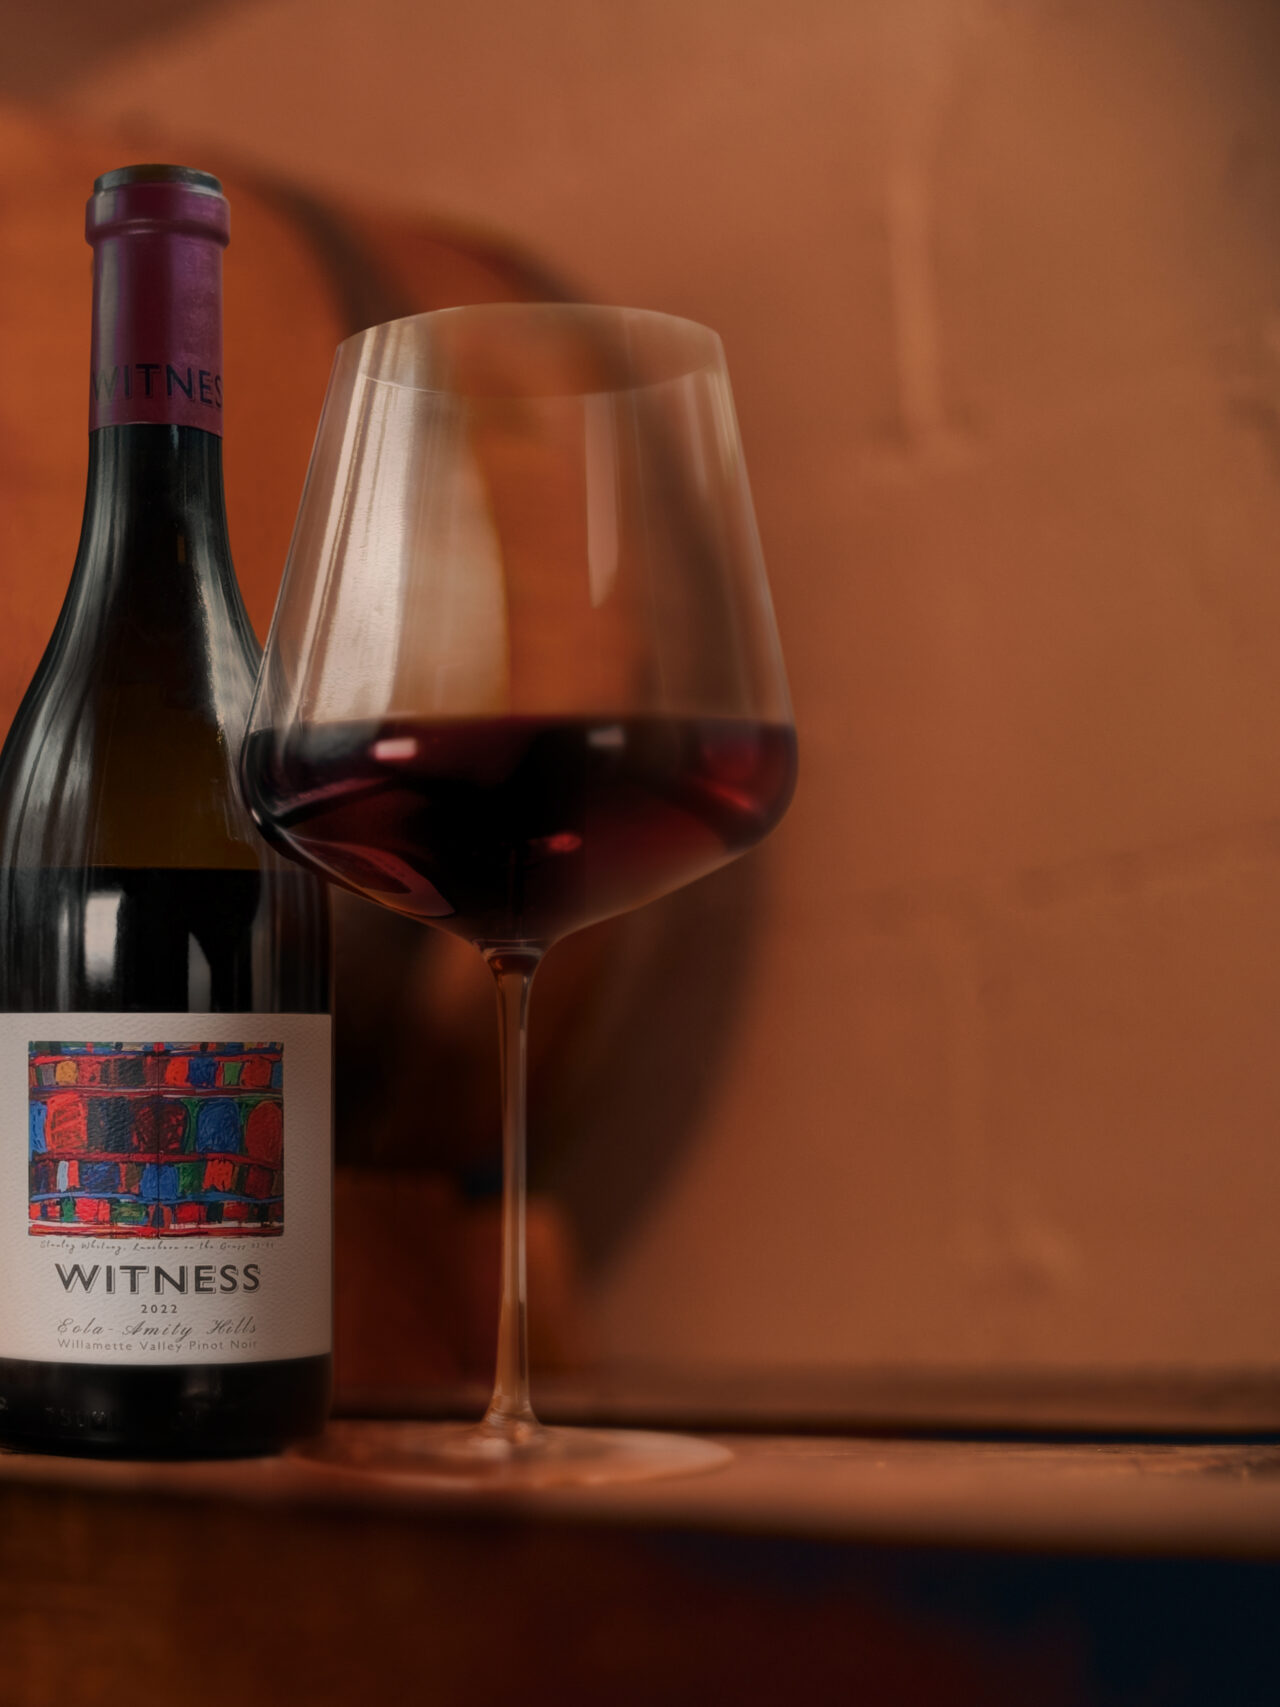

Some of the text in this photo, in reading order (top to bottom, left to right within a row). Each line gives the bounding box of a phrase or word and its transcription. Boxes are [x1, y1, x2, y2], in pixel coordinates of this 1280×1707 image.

[55, 1263, 261, 1295] WITNESS
[141, 1304, 177, 1314] 2022
[206, 1316, 257, 1335] Hills
[57, 1338, 258, 1353] Willamette Valley Pinot Noir
